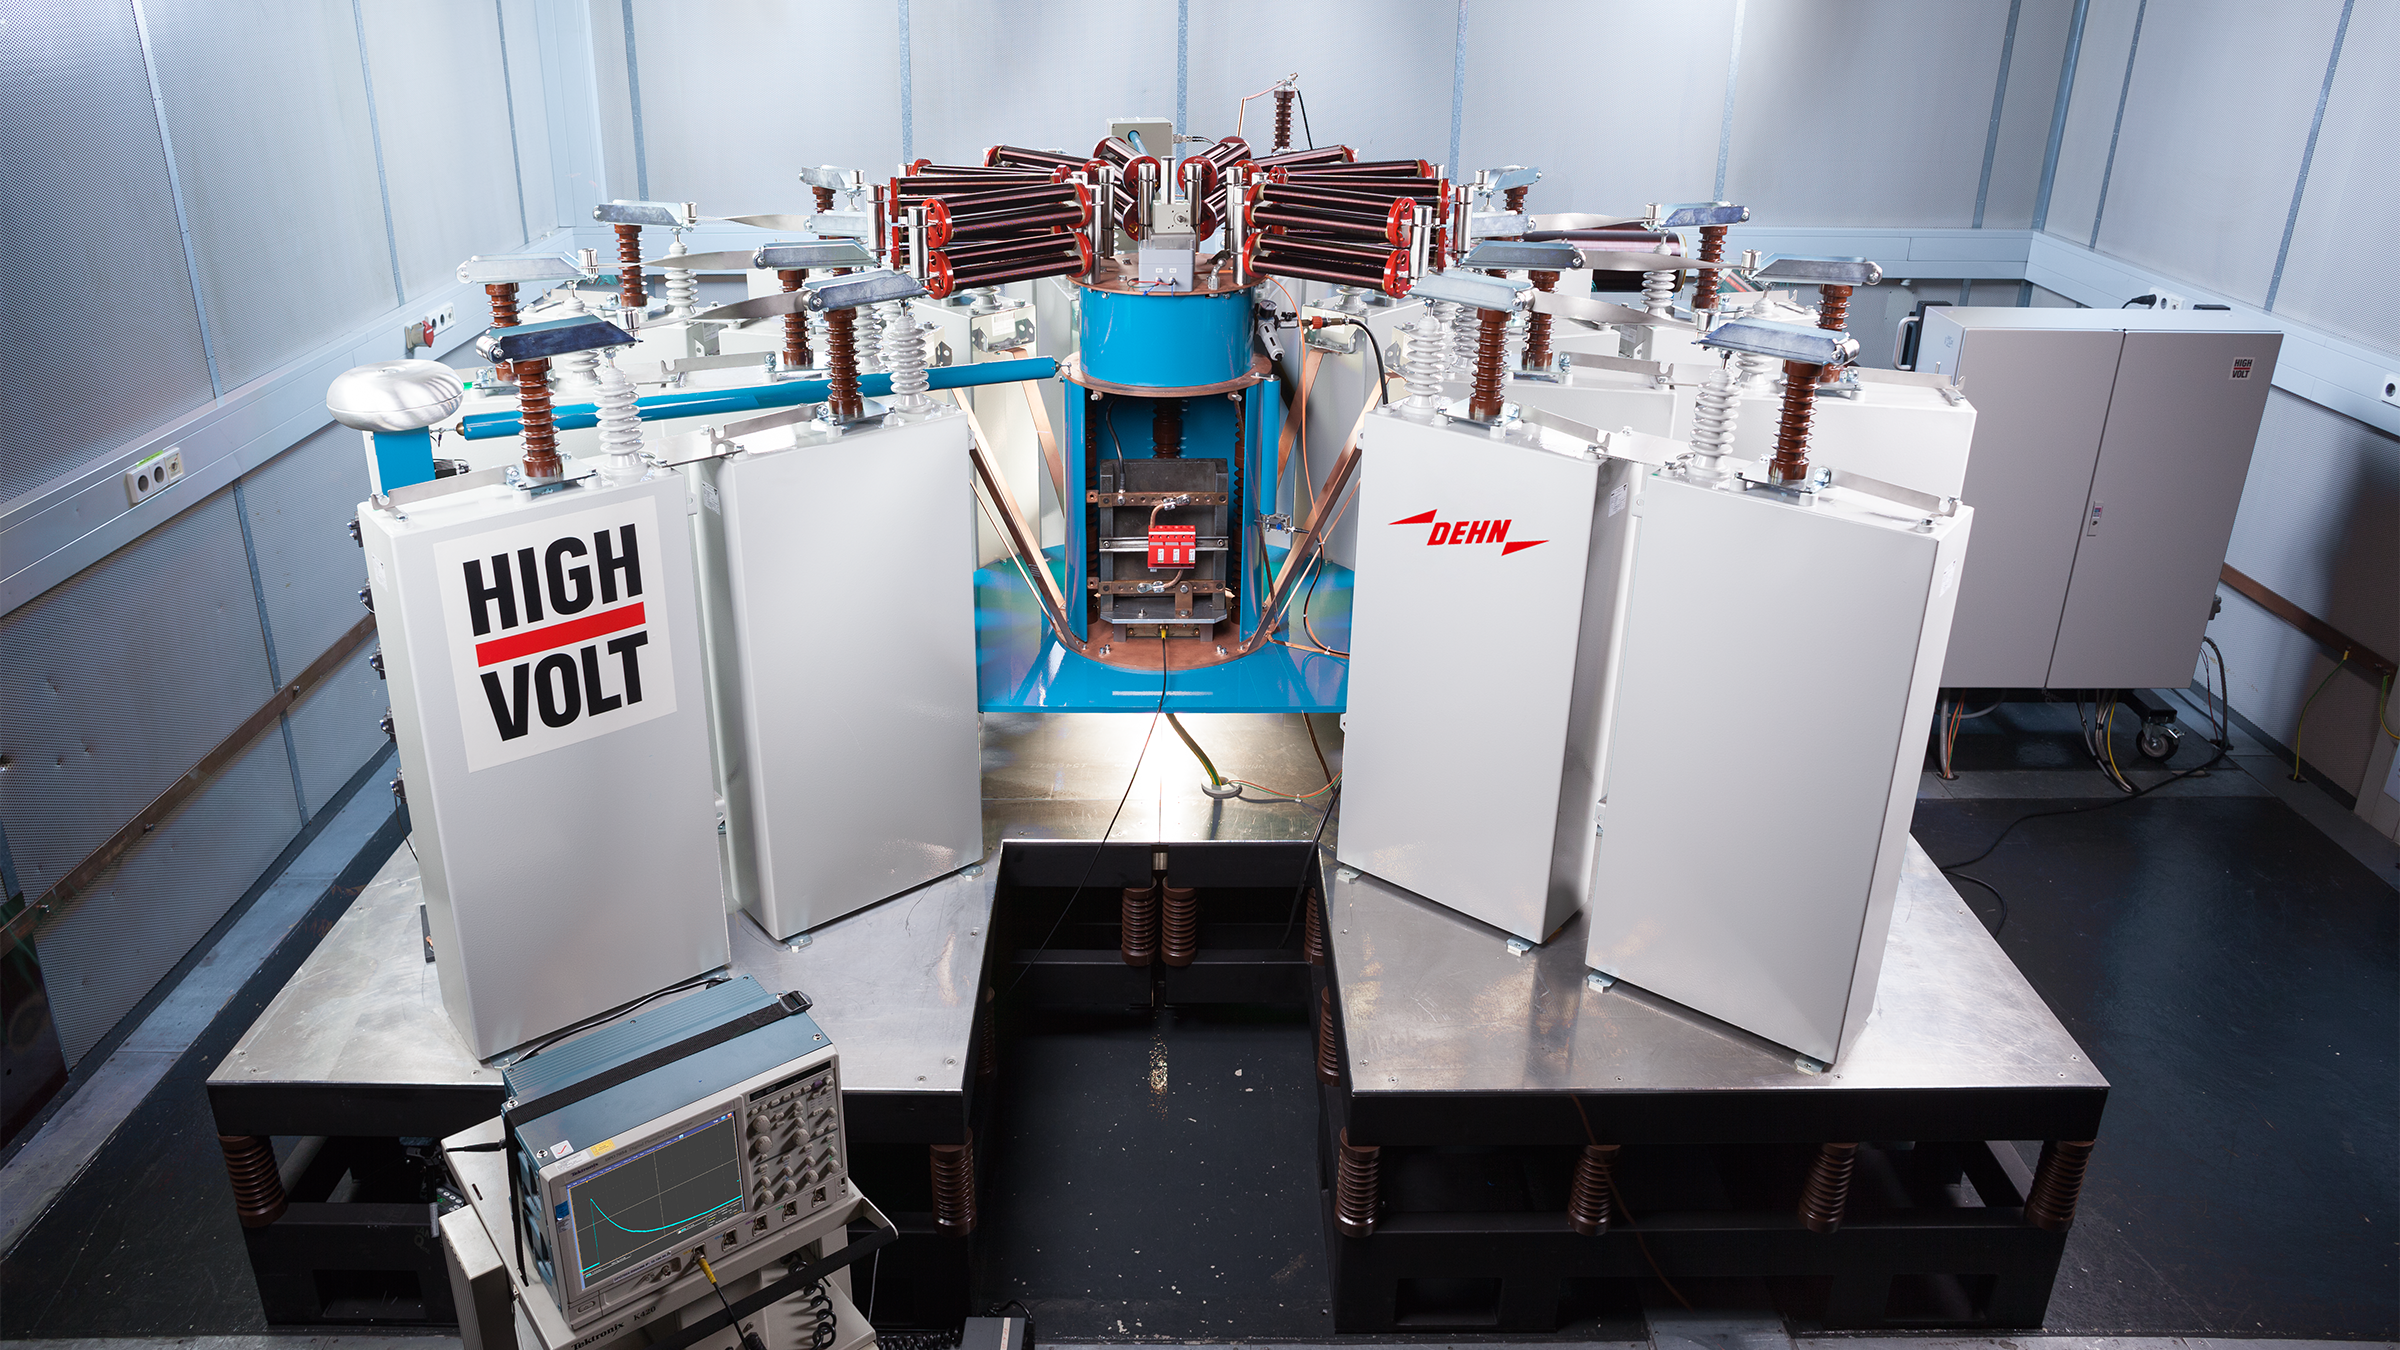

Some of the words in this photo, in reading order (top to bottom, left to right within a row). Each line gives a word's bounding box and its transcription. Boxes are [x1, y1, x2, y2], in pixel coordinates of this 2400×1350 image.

[2232, 370, 2250, 378] VOLT
[2234, 359, 2253, 367] HIGH
[1426, 518, 1512, 547] DEHN
[463, 523, 643, 636] HIGH
[480, 630, 648, 742] VOLT
[571, 1162, 599, 1177] Tektronix
[570, 1321, 625, 1350] Tektronix
[633, 1305, 657, 1322] K420
